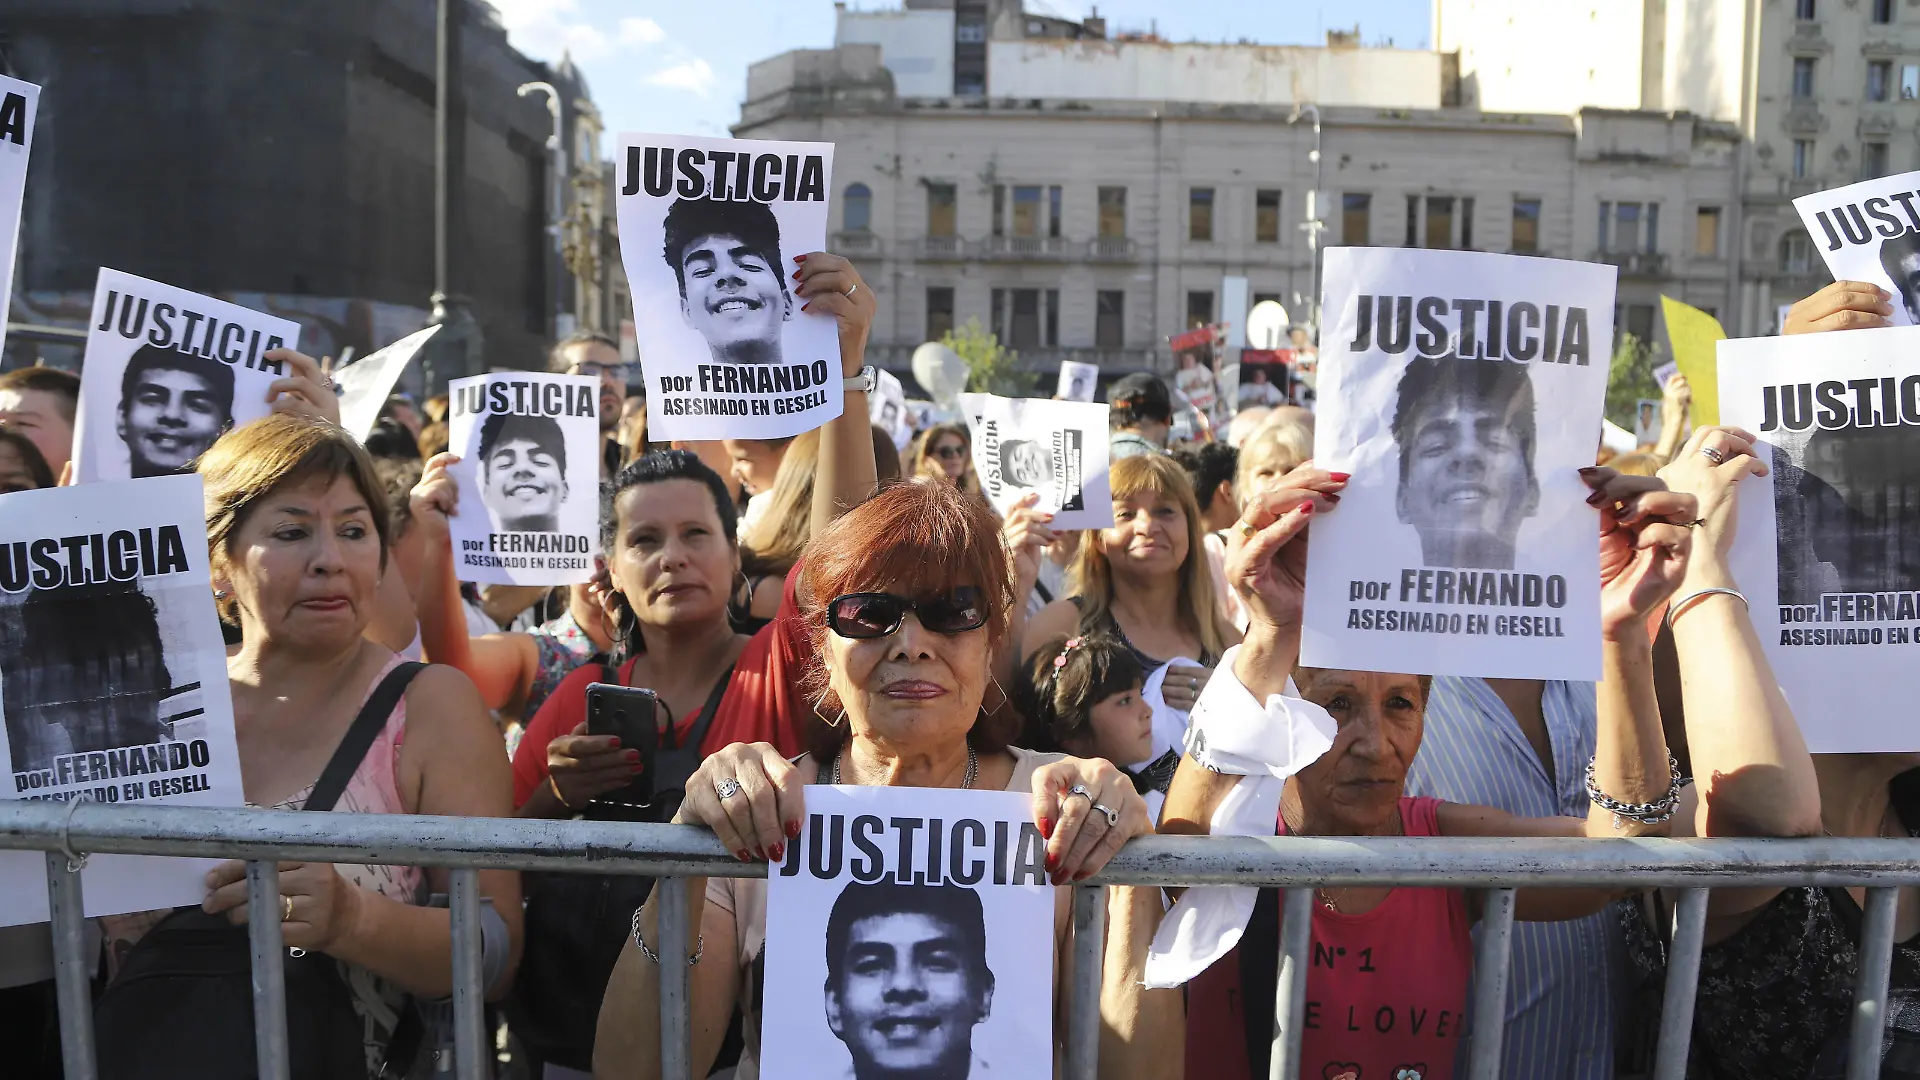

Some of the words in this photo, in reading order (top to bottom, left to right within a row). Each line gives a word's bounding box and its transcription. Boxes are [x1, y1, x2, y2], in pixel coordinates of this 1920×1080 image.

[0, 92, 26, 146] A
[622, 146, 825, 202] JUSTICIA
[1815, 190, 1920, 251] JUST
[99, 290, 284, 376] JUSTICIA
[1350, 294, 1590, 366] JUSTICIA
[660, 375, 692, 393] por
[698, 360, 828, 394] FERNANDO
[455, 382, 595, 417] JUSTICIA
[663, 398, 748, 416] ASESINADO
[752, 399, 770, 416] EN
[774, 390, 827, 415] GESELL
[0, 525, 190, 592] USTICIA
[462, 540, 484, 551] por
[489, 533, 589, 554] FERNANDO
[464, 554, 527, 568] ASESINADO
[531, 557, 544, 569] EN
[548, 557, 588, 569] GESELL
[1350, 580, 1391, 601] por
[1400, 569, 1567, 608] FERNANDO
[1347, 609, 1461, 634] ASESINADO
[1466, 614, 1489, 635] EN
[1495, 615, 1564, 637] GESELL
[1780, 607, 1815, 624] por
[1823, 594, 1920, 621] FERNA
[1780, 628, 1882, 645] ASESINADO
[1887, 627, 1909, 644] EN
[15, 772, 51, 792] por
[56, 739, 210, 784] FERNANDO
[123, 781, 145, 800] EN
[149, 773, 211, 798] GESELL
[780, 814, 1046, 885] JUSTICIA
[1359, 948, 1375, 972] 1
